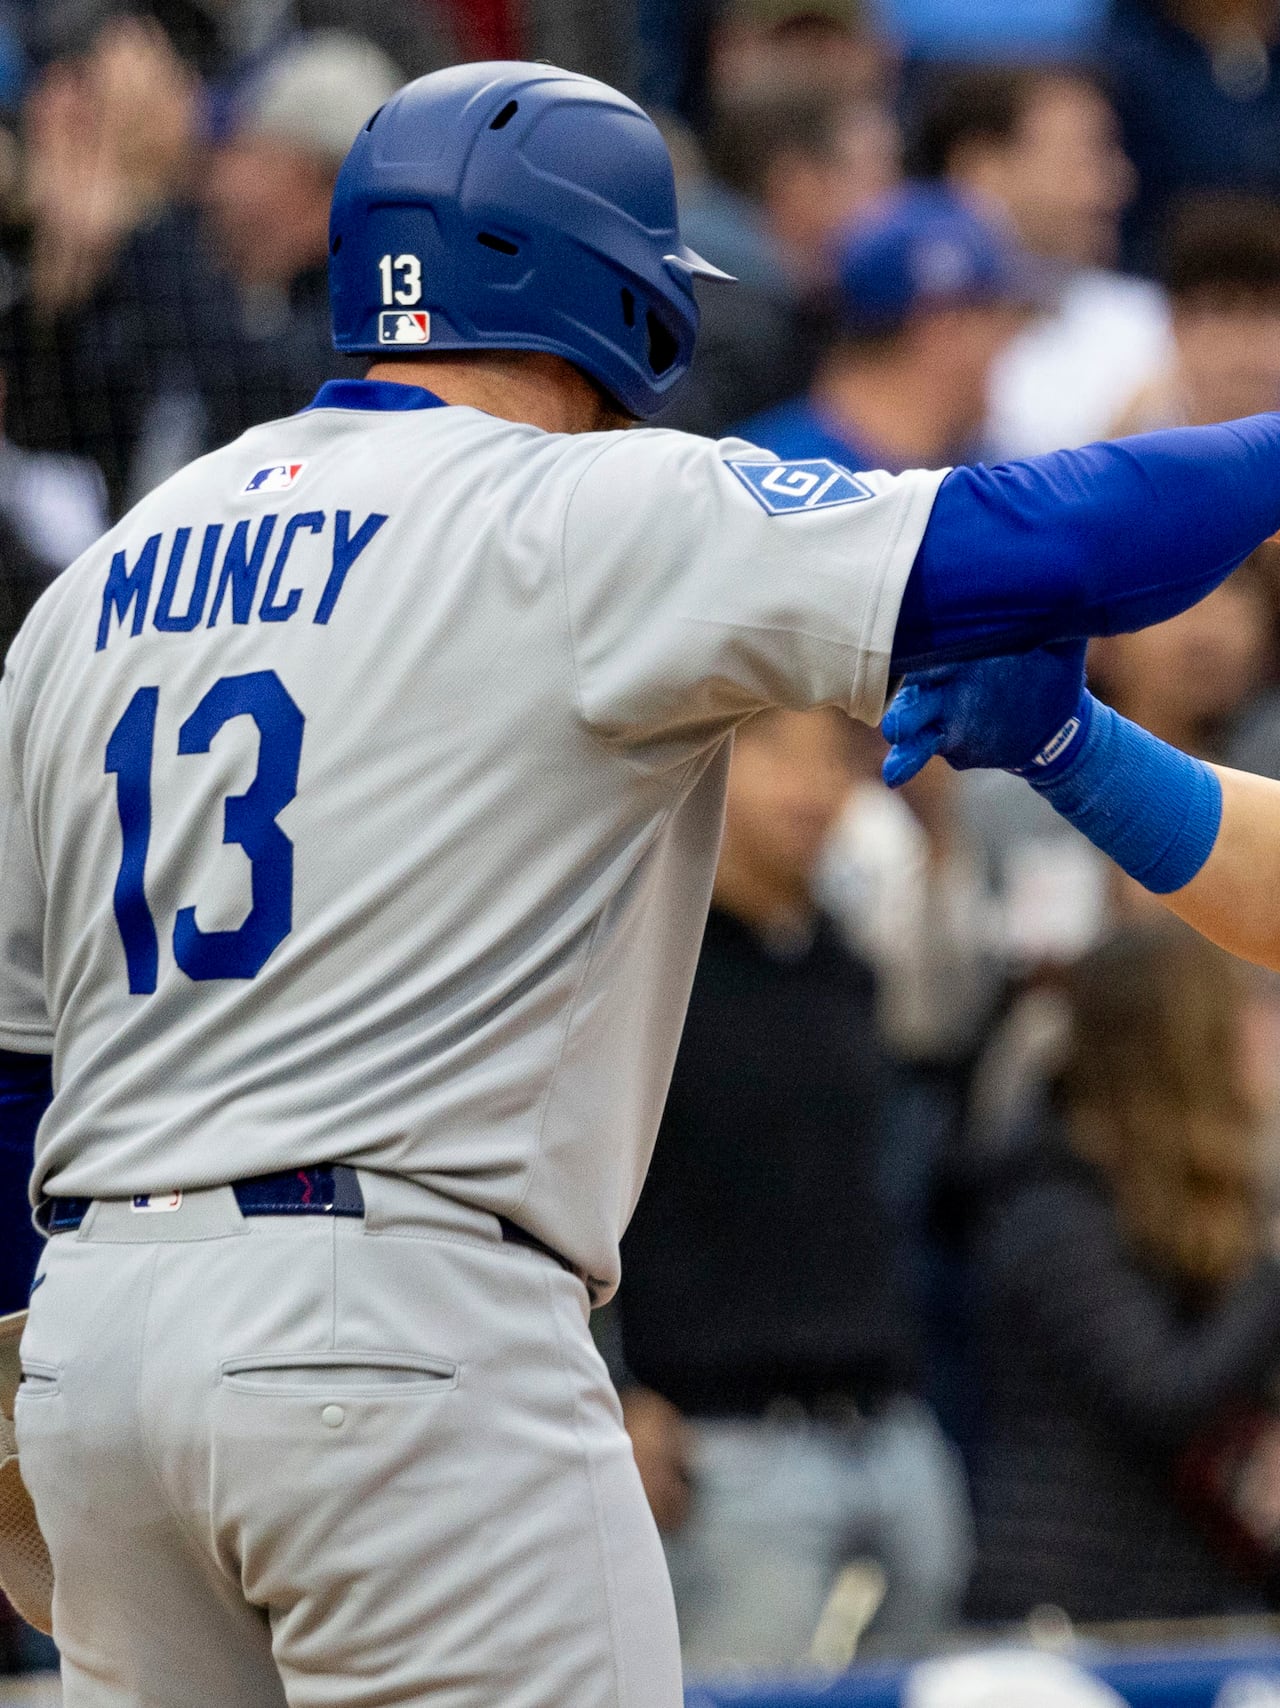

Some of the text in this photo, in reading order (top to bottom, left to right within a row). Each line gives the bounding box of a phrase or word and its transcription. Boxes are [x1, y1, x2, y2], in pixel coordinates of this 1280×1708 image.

[378, 254, 422, 306] 13
[95, 509, 389, 652] MUNCY
[104, 669, 306, 996] 13
